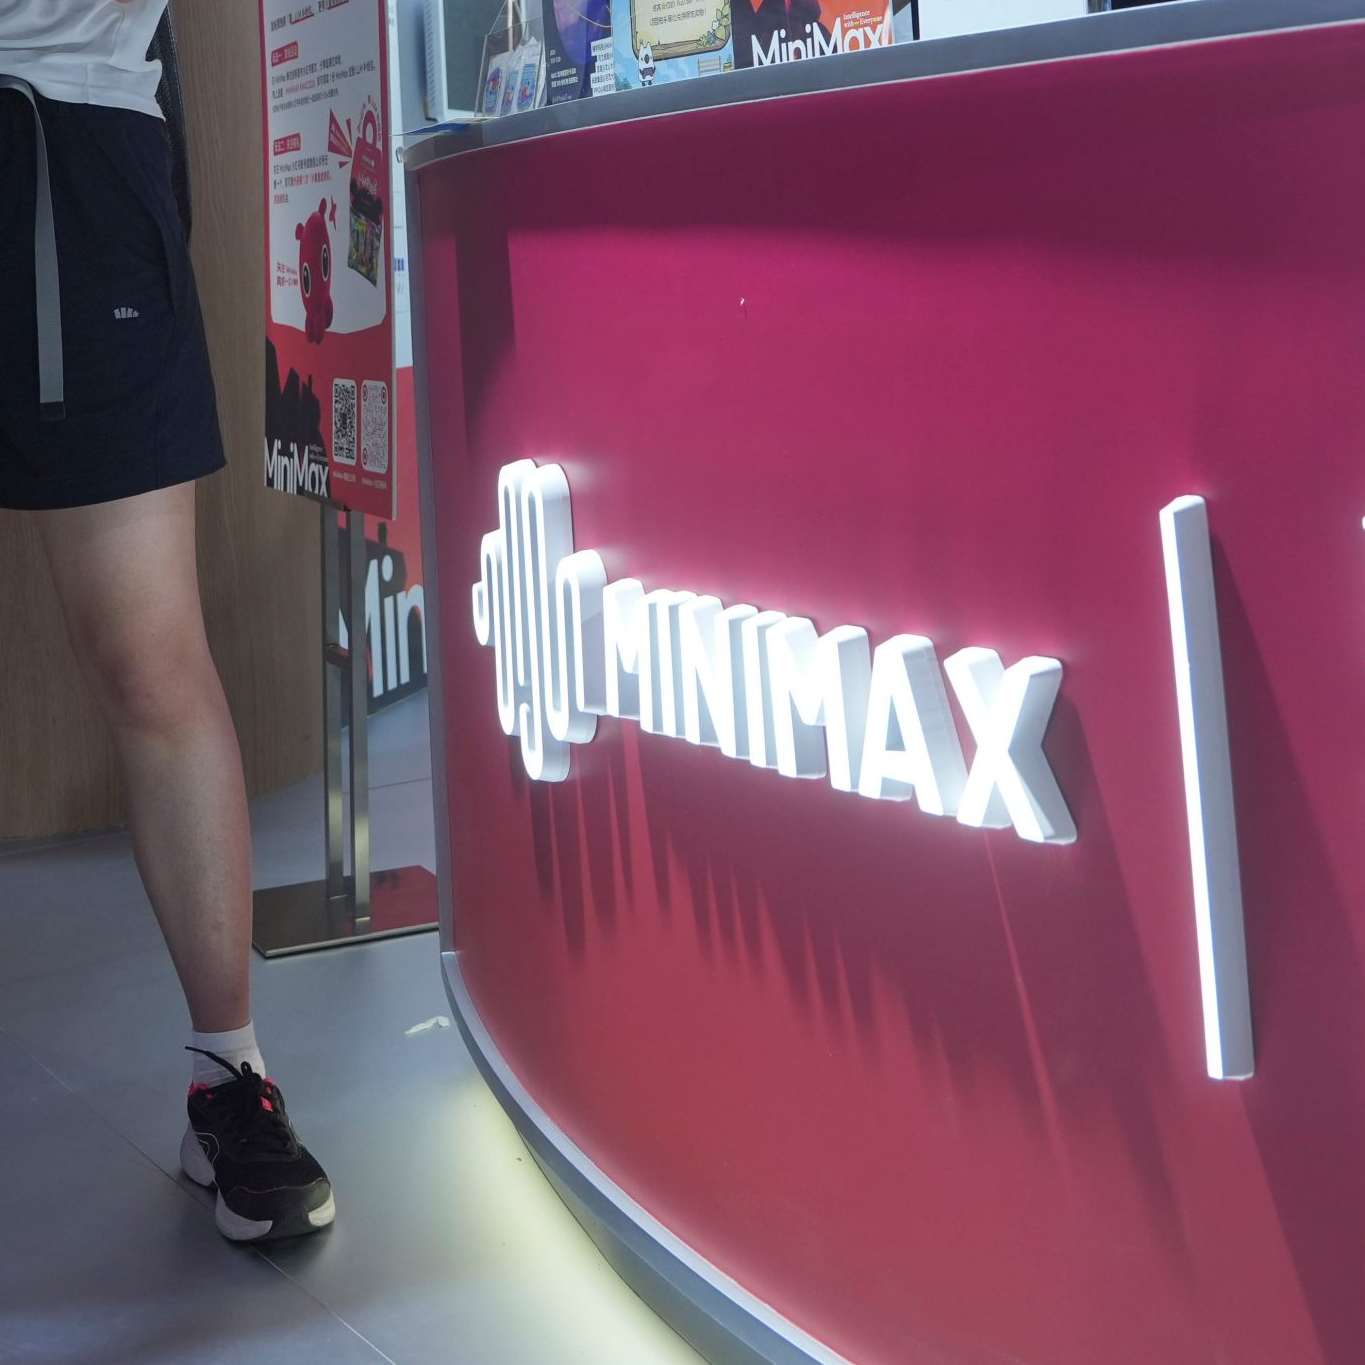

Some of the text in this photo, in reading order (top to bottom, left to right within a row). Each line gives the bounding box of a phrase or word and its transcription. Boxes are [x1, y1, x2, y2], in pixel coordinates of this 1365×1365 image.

[751, 17, 884, 68] MiniMax
[843, 10, 871, 21] Intelligence
[264, 436, 330, 498] MiniMax
[602, 577, 1078, 845] MINIMAX
